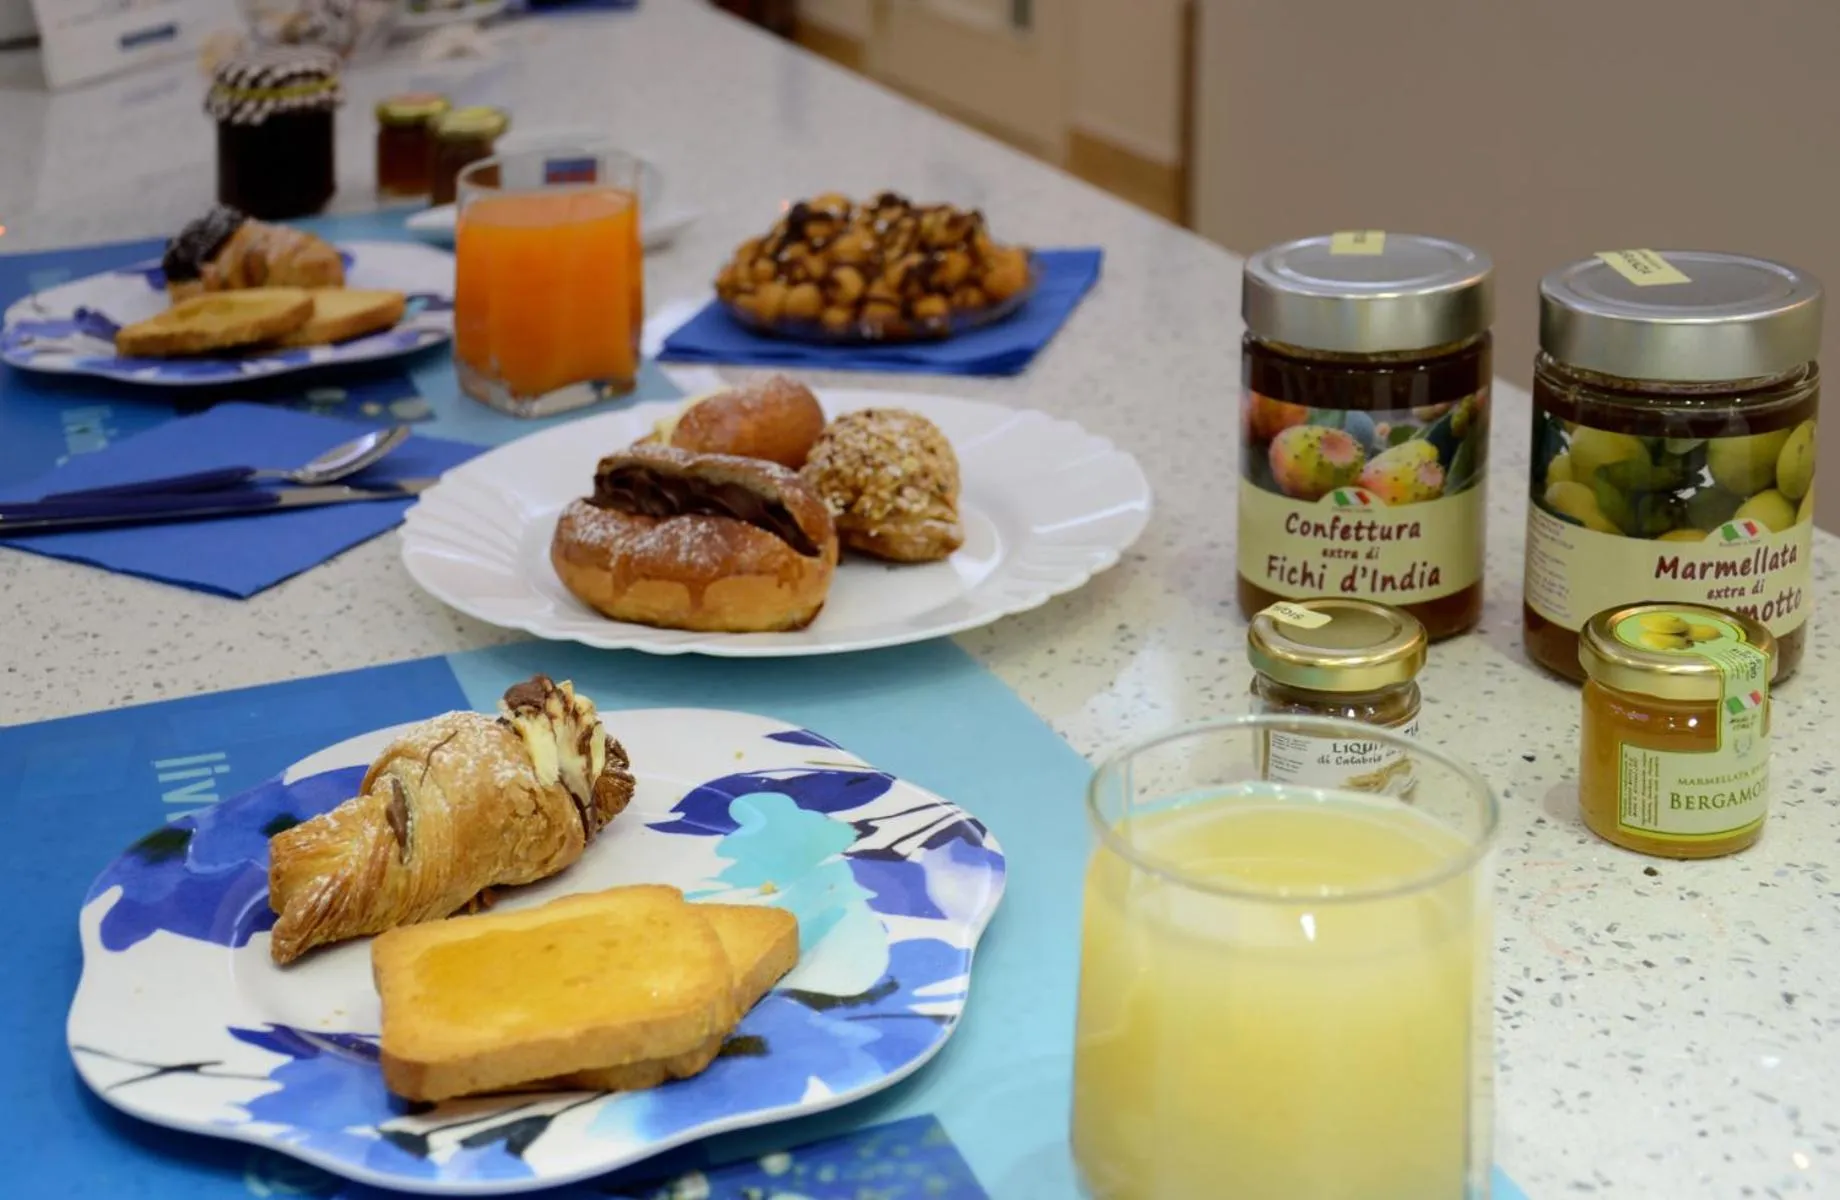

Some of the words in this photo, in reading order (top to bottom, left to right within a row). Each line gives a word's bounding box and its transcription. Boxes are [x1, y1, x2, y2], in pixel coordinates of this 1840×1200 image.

[1285, 512, 1421, 541] Confettura
[1322, 547, 1358, 560] extra
[1365, 547, 1381, 560] di
[1654, 544, 1798, 580] Marmellata
[1266, 555, 1328, 590] Fichi
[1340, 561, 1442, 592] d'India
[1707, 586, 1746, 601] extra
[1751, 579, 1765, 595] di
[1735, 587, 1802, 622] motto
[1317, 755, 1331, 765] di
[155, 752, 230, 823] liv
